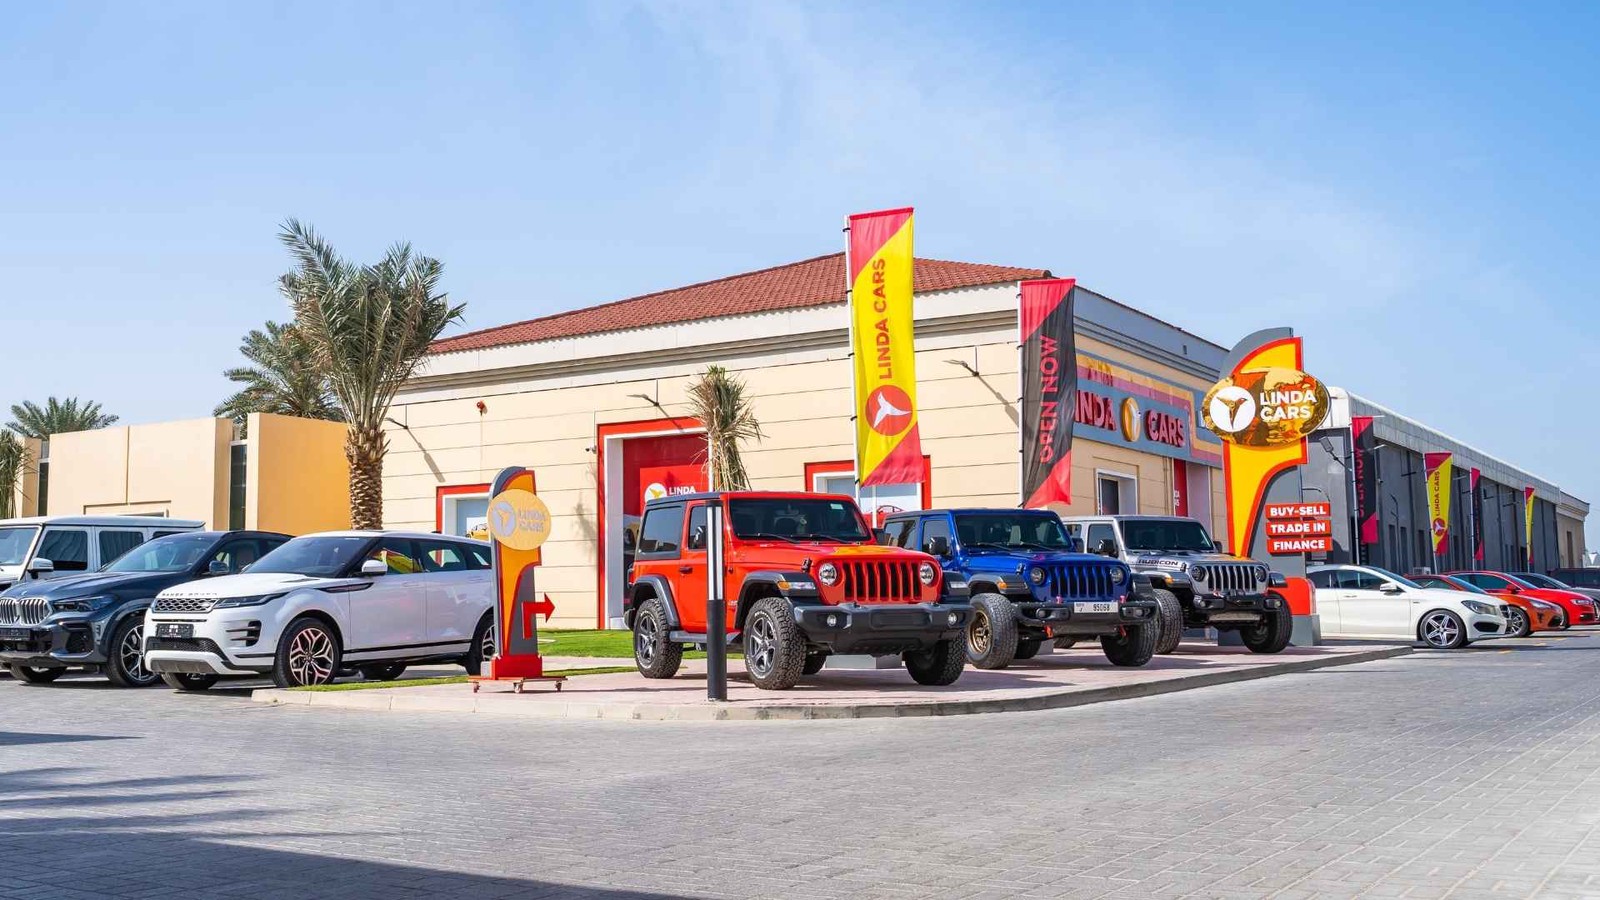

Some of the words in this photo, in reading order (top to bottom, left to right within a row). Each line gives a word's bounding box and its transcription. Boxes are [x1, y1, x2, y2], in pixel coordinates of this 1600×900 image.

[872, 258, 887, 313] CARS
[875, 318, 893, 380] LINDA
[1040, 335, 1059, 393] NOW
[1260, 390, 1317, 406] LINDA
[1075, 389, 1116, 431] INDA
[1145, 409, 1185, 447] CARS
[1260, 406, 1312, 421] CARS
[1040, 401, 1058, 463] OPEN
[669, 486, 696, 495] LINDA
[1270, 506, 1327, 517] BUY-SELL
[1270, 523, 1310, 533] TRADE
[1313, 522, 1326, 532] IN
[1273, 540, 1325, 551] FINANCE
